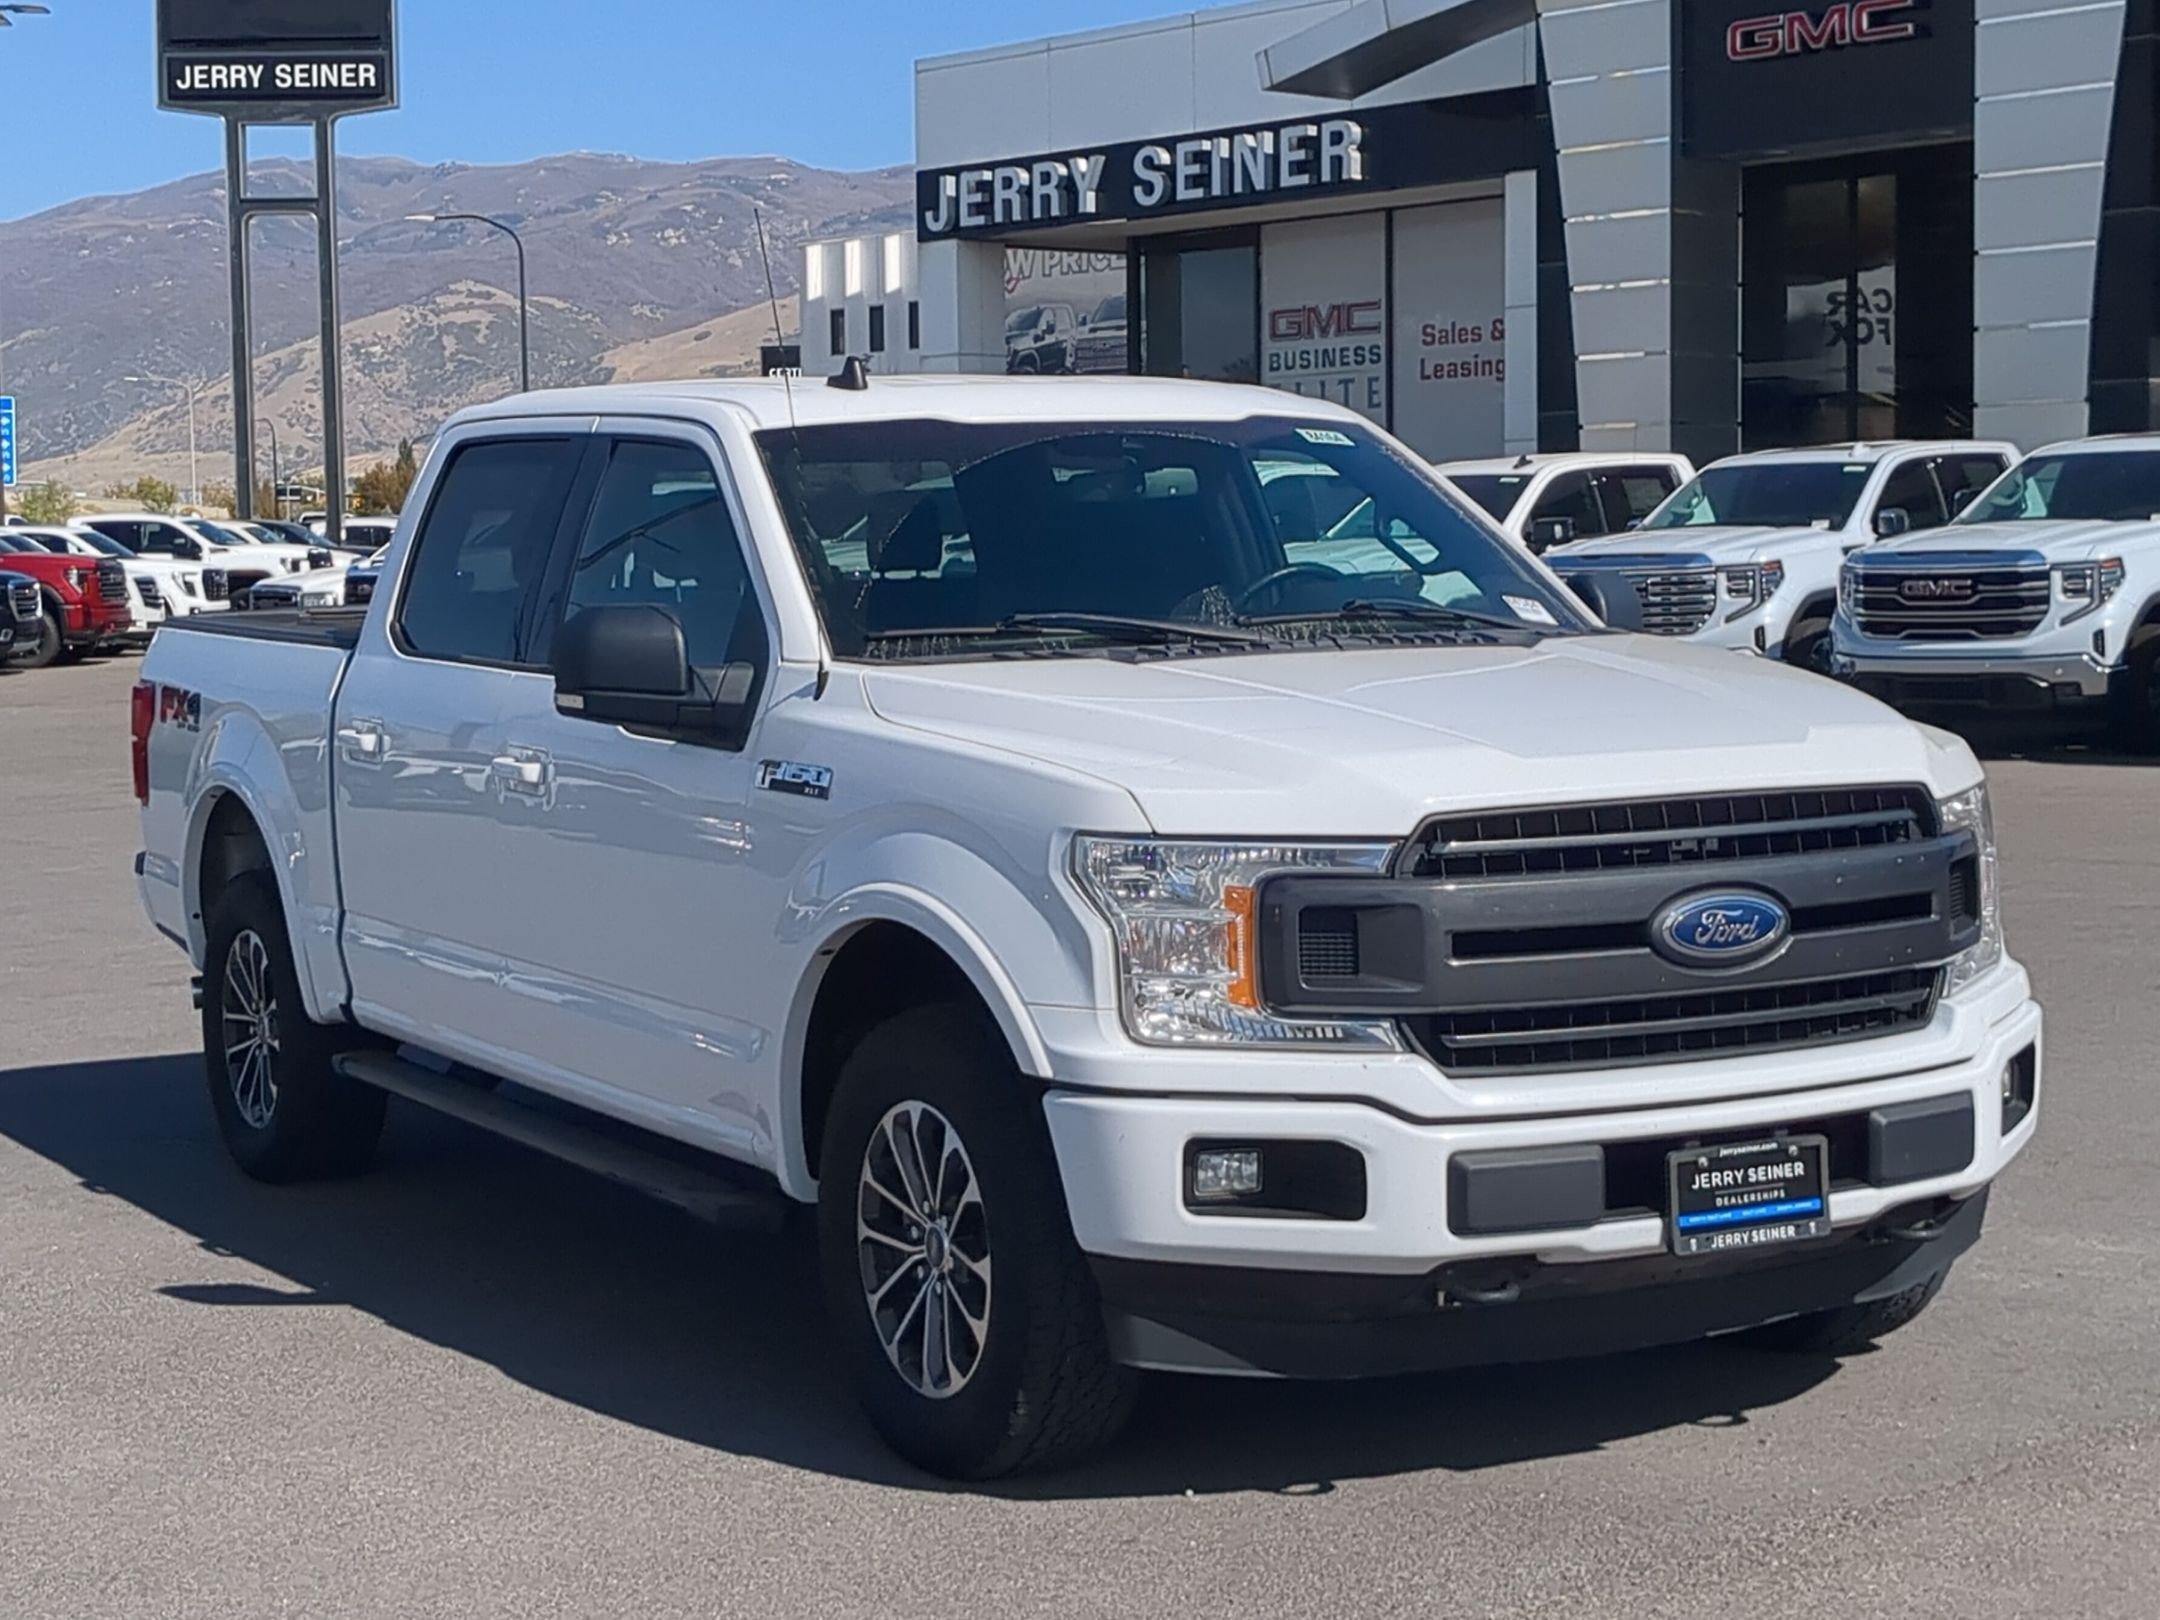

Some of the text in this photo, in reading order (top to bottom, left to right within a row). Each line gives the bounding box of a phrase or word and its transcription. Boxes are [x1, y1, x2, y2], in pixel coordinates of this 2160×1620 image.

[1727, 0, 1915, 61] GMC
[176, 63, 376, 89] JERRY SEINER
[924, 119, 1364, 232] JERRY SEINER
[1269, 299, 1381, 342] GMC
[1422, 318, 1505, 346] Sales &
[1269, 345, 1381, 371] BUSINESS
[1420, 354, 1505, 382] Leasing
[1901, 579, 1973, 596] GMC
[160, 685, 201, 724] FX4
[1695, 909, 1759, 944] Ford
[1691, 1162, 1805, 1189] JERRY SEINER
[1716, 1190, 1785, 1207] DEALERSHIPS
[1711, 1226, 1796, 1248] JERRY SEINER
